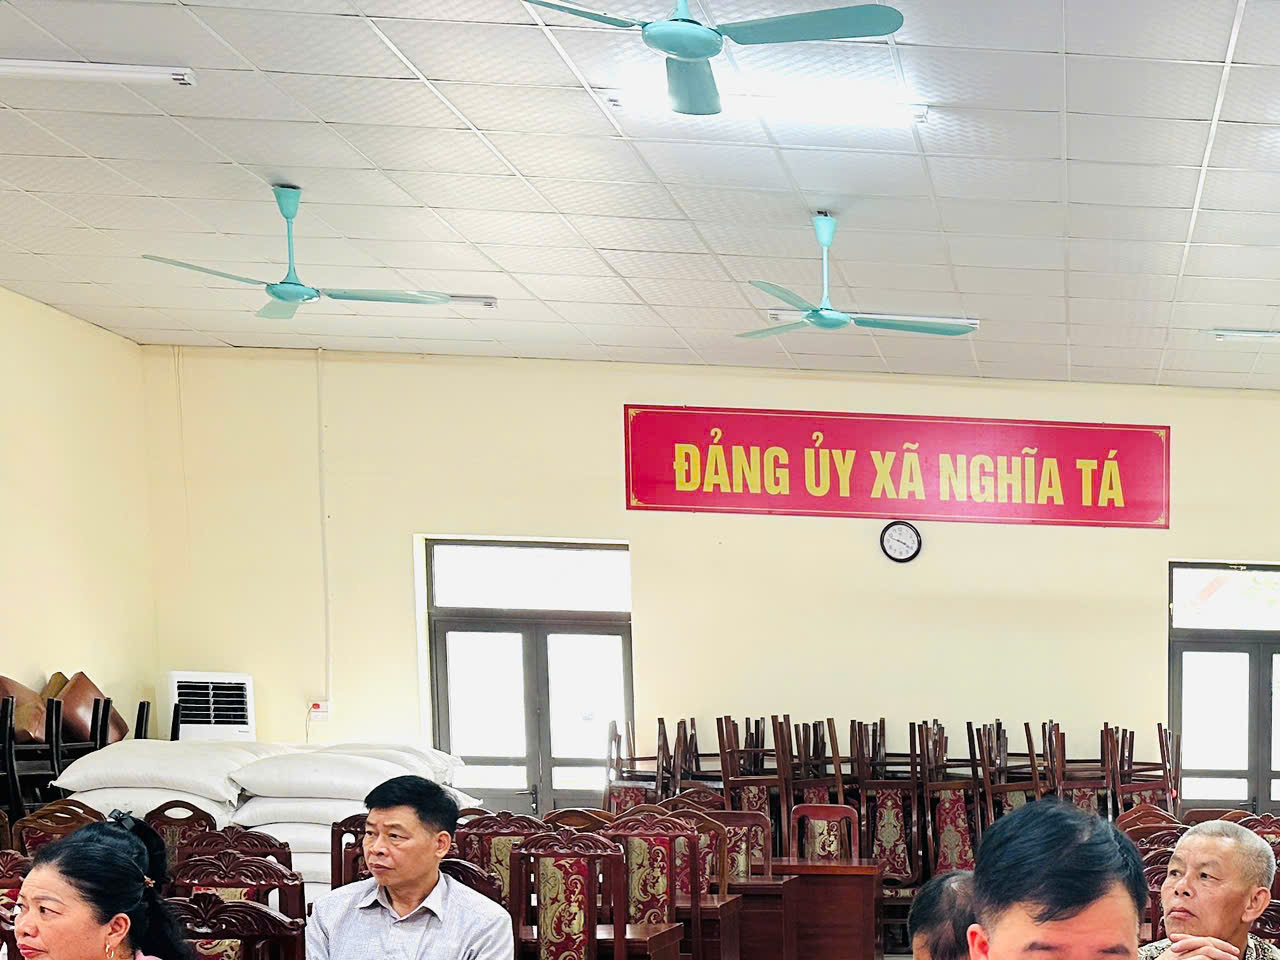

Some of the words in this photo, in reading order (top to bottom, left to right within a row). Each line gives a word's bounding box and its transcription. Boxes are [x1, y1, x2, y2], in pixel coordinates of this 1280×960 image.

[673, 427, 790, 496] ĐẢNG
[804, 431, 857, 497] ỦY
[870, 442, 926, 500] XÃ
[939, 446, 1065, 506] NGHĨA
[1076, 449, 1125, 508] TÁ
